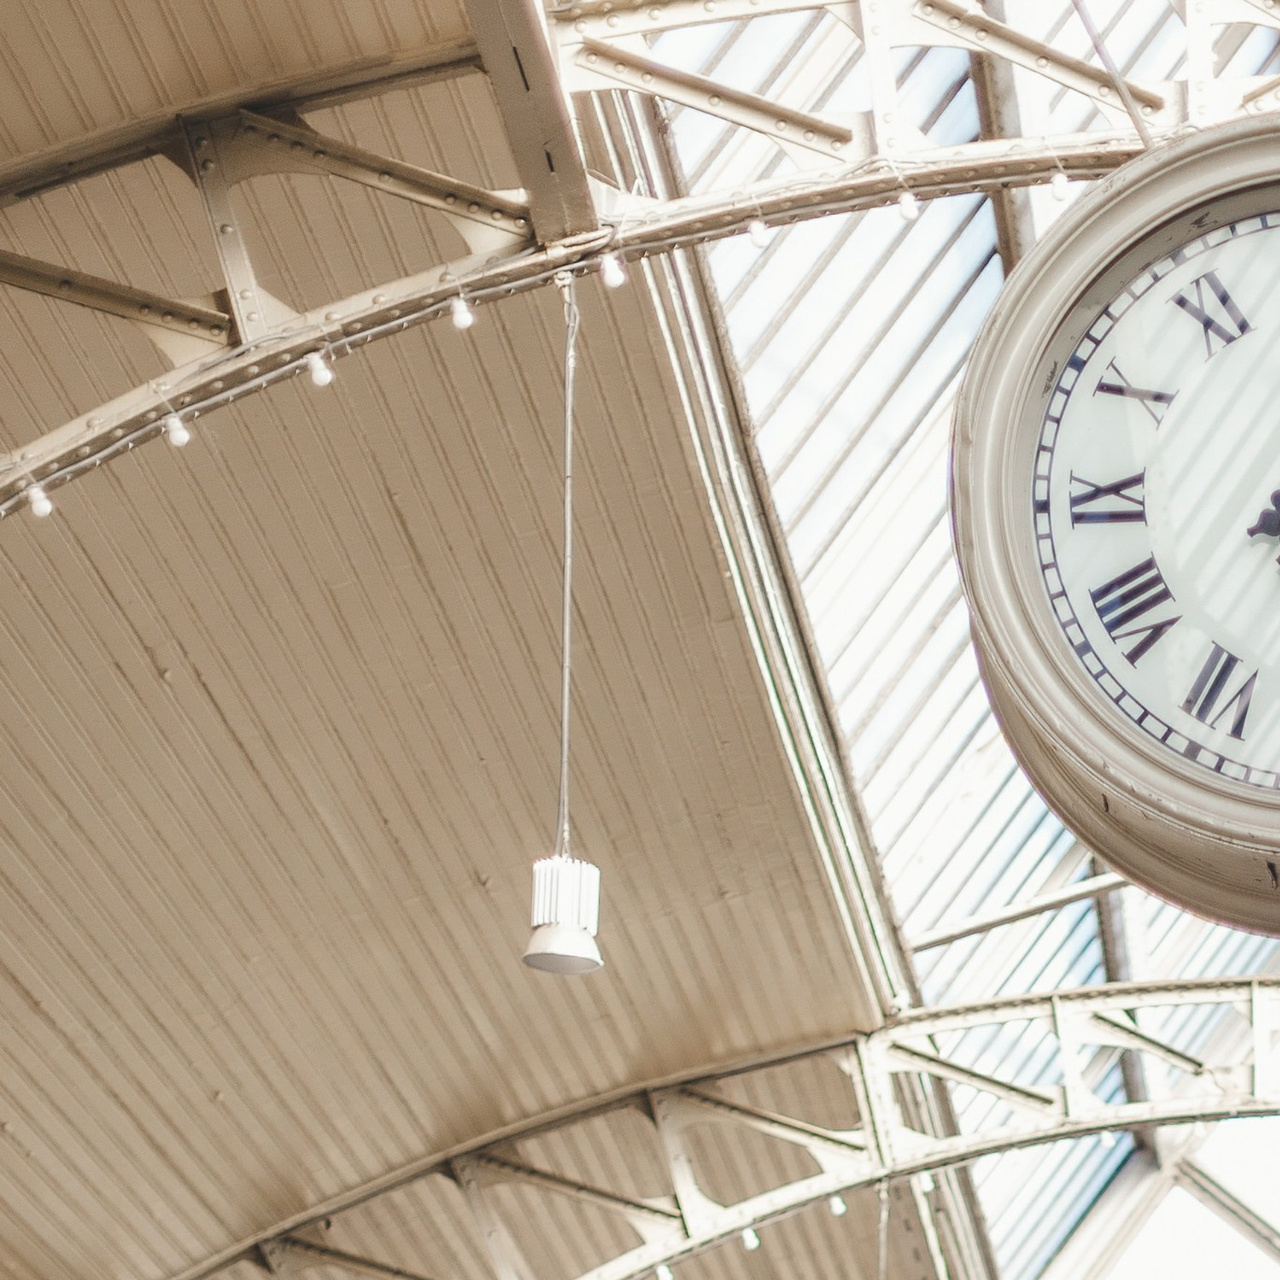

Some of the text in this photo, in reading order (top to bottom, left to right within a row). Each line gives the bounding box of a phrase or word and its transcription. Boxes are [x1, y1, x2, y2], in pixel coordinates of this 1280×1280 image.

[1167, 267, 1256, 361] XI
[1093, 357, 1179, 428] X
[1069, 466, 1147, 530] IX
[1089, 551, 1182, 668] VIII
[1177, 641, 1260, 741] VII
